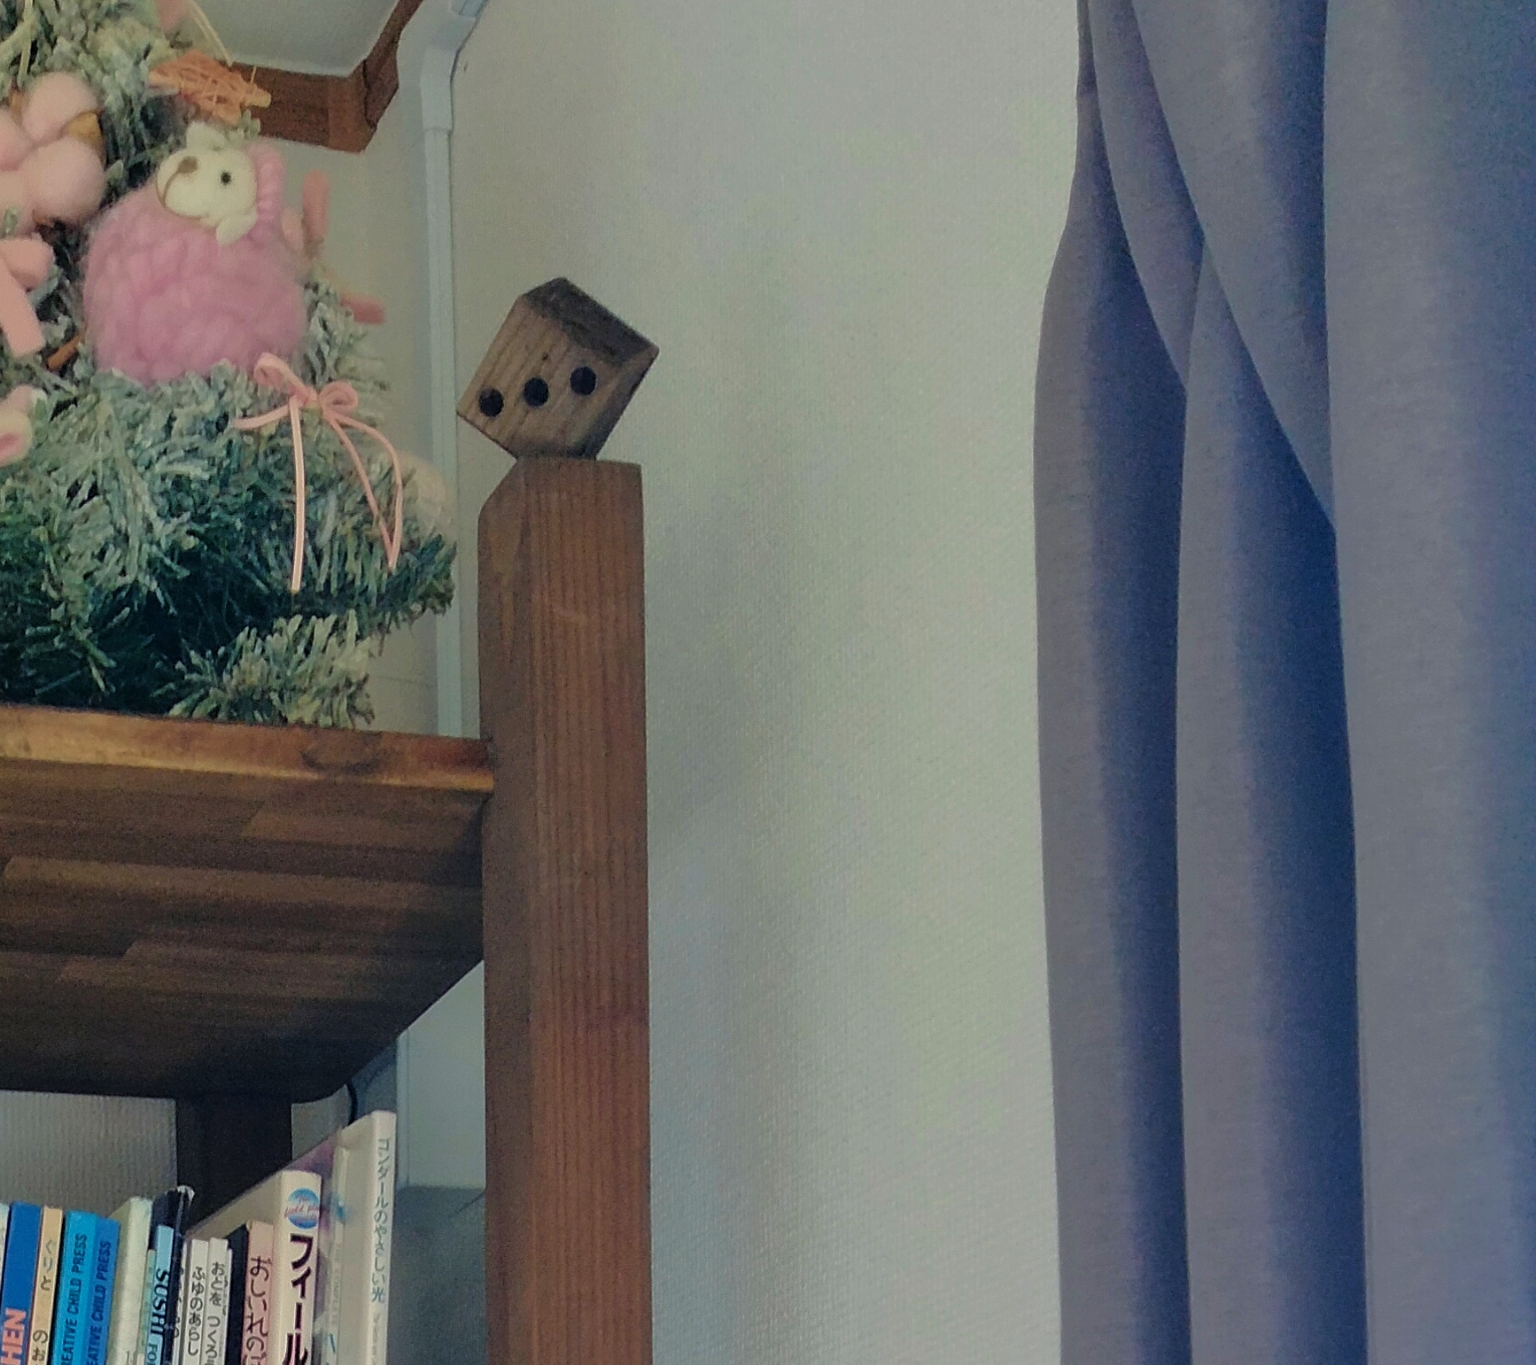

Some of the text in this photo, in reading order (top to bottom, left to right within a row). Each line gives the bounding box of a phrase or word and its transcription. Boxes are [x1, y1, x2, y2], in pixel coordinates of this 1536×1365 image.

[71, 1233, 88, 1273] PRESS
[95, 1240, 112, 1282] PRESS
[66, 1278, 83, 1315] CHILD
[90, 1284, 107, 1322] CHILD
[151, 1268, 169, 1339] SUSHI
[187, 1266, 206, 1357] ふゆのあらし
